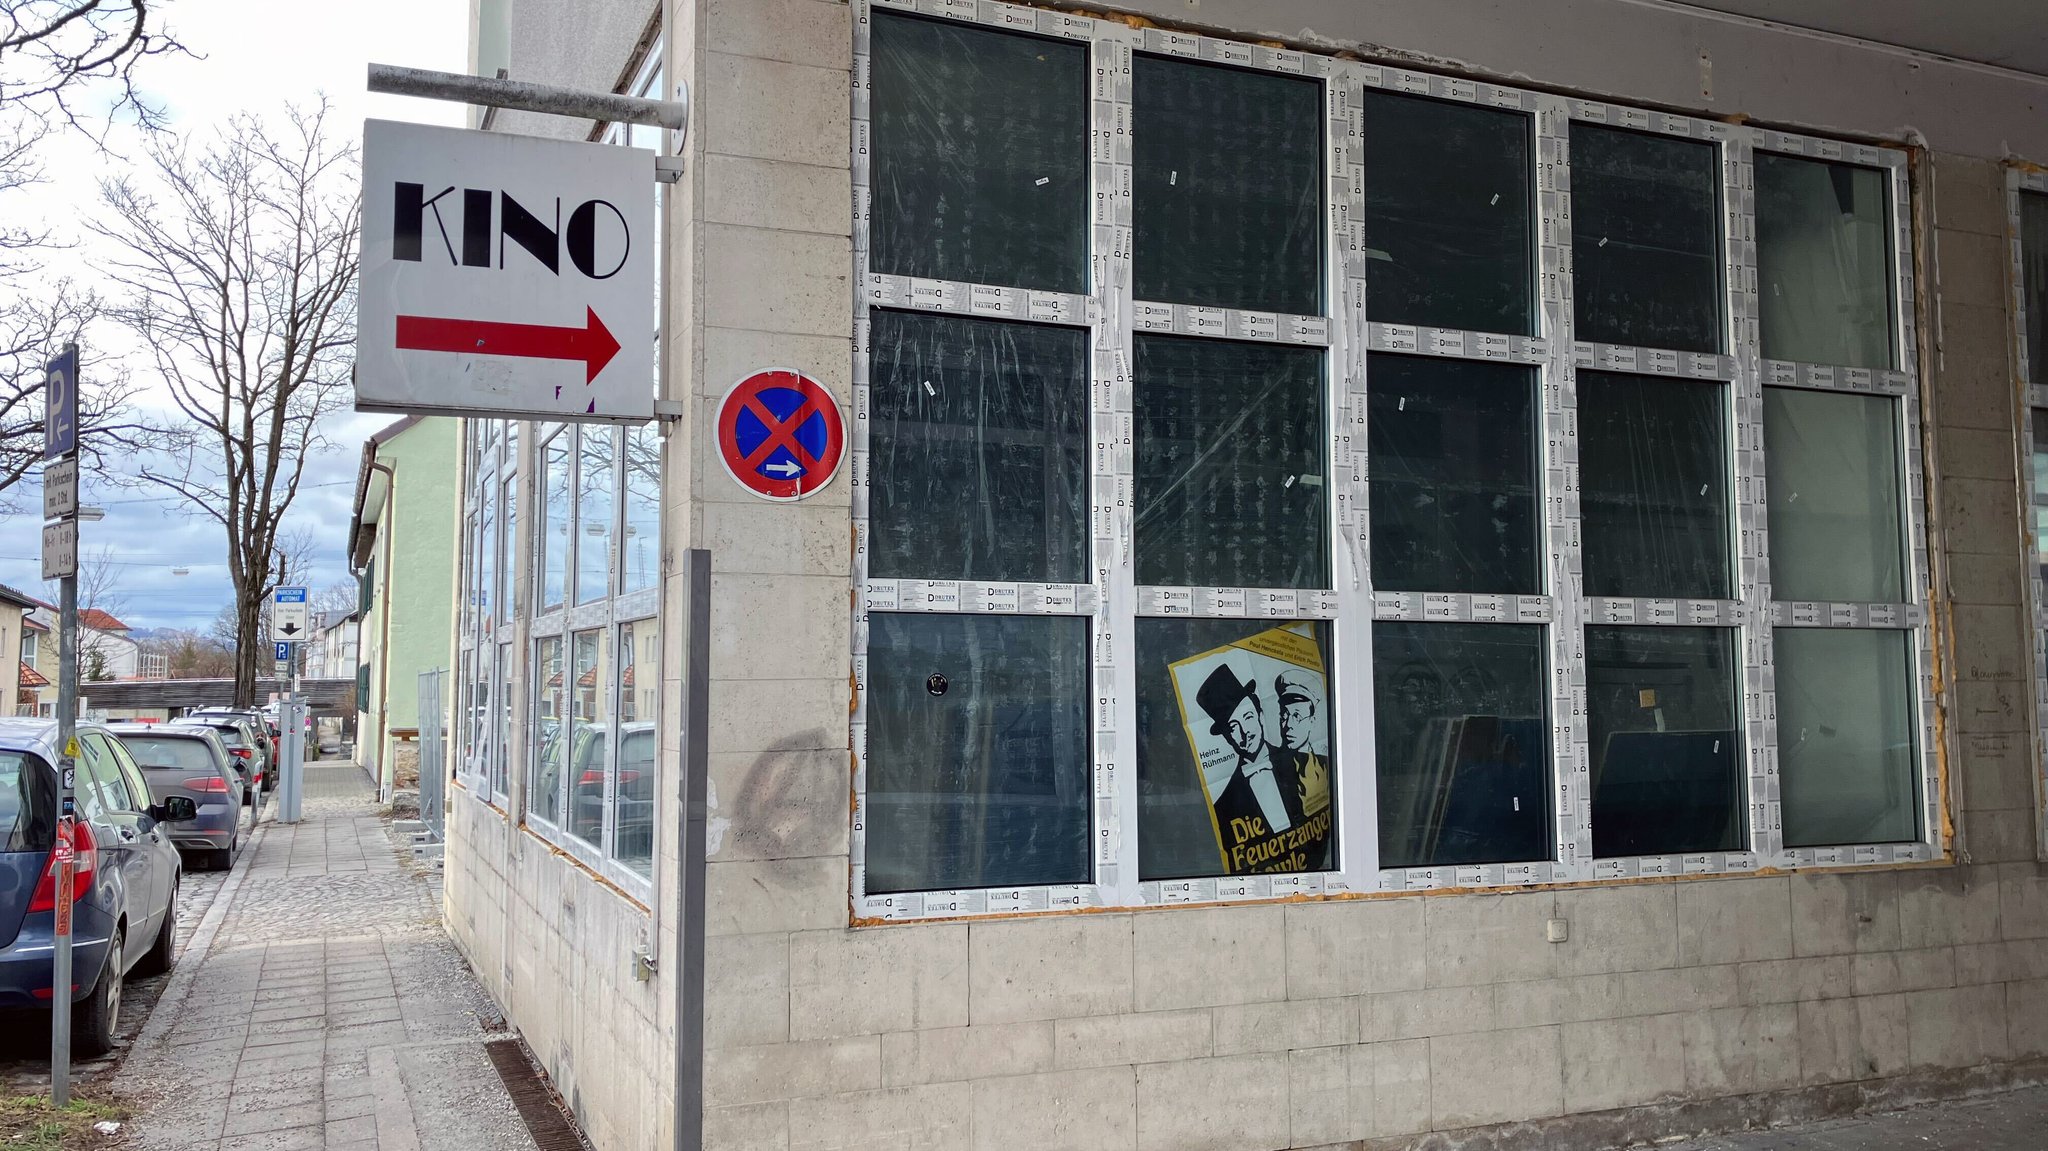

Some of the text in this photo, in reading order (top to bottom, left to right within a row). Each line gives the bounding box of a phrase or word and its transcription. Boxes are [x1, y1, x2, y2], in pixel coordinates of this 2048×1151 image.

[953, 1, 974, 9] DRUTEX
[1012, 16, 1033, 24] DRUTEX
[1070, 18, 1090, 27] DRUTEX
[393, 181, 630, 280] KINO
[914, 288, 935, 296] DRUTEX
[974, 287, 994, 295] DRUTEX
[974, 302, 995, 310] DRUTEX
[49, 370, 65, 446] P
[52, 470, 73, 487] Parkschein
[1249, 640, 1260, 649] Paul
[278, 644, 286, 658] P
[1199, 747, 1220, 760] Heinz
[1202, 753, 1236, 770] Rühmann
[1230, 815, 1265, 845] Die
[990, 891, 1012, 900] DRUTEX
[928, 902, 949, 911] DRUTEX
